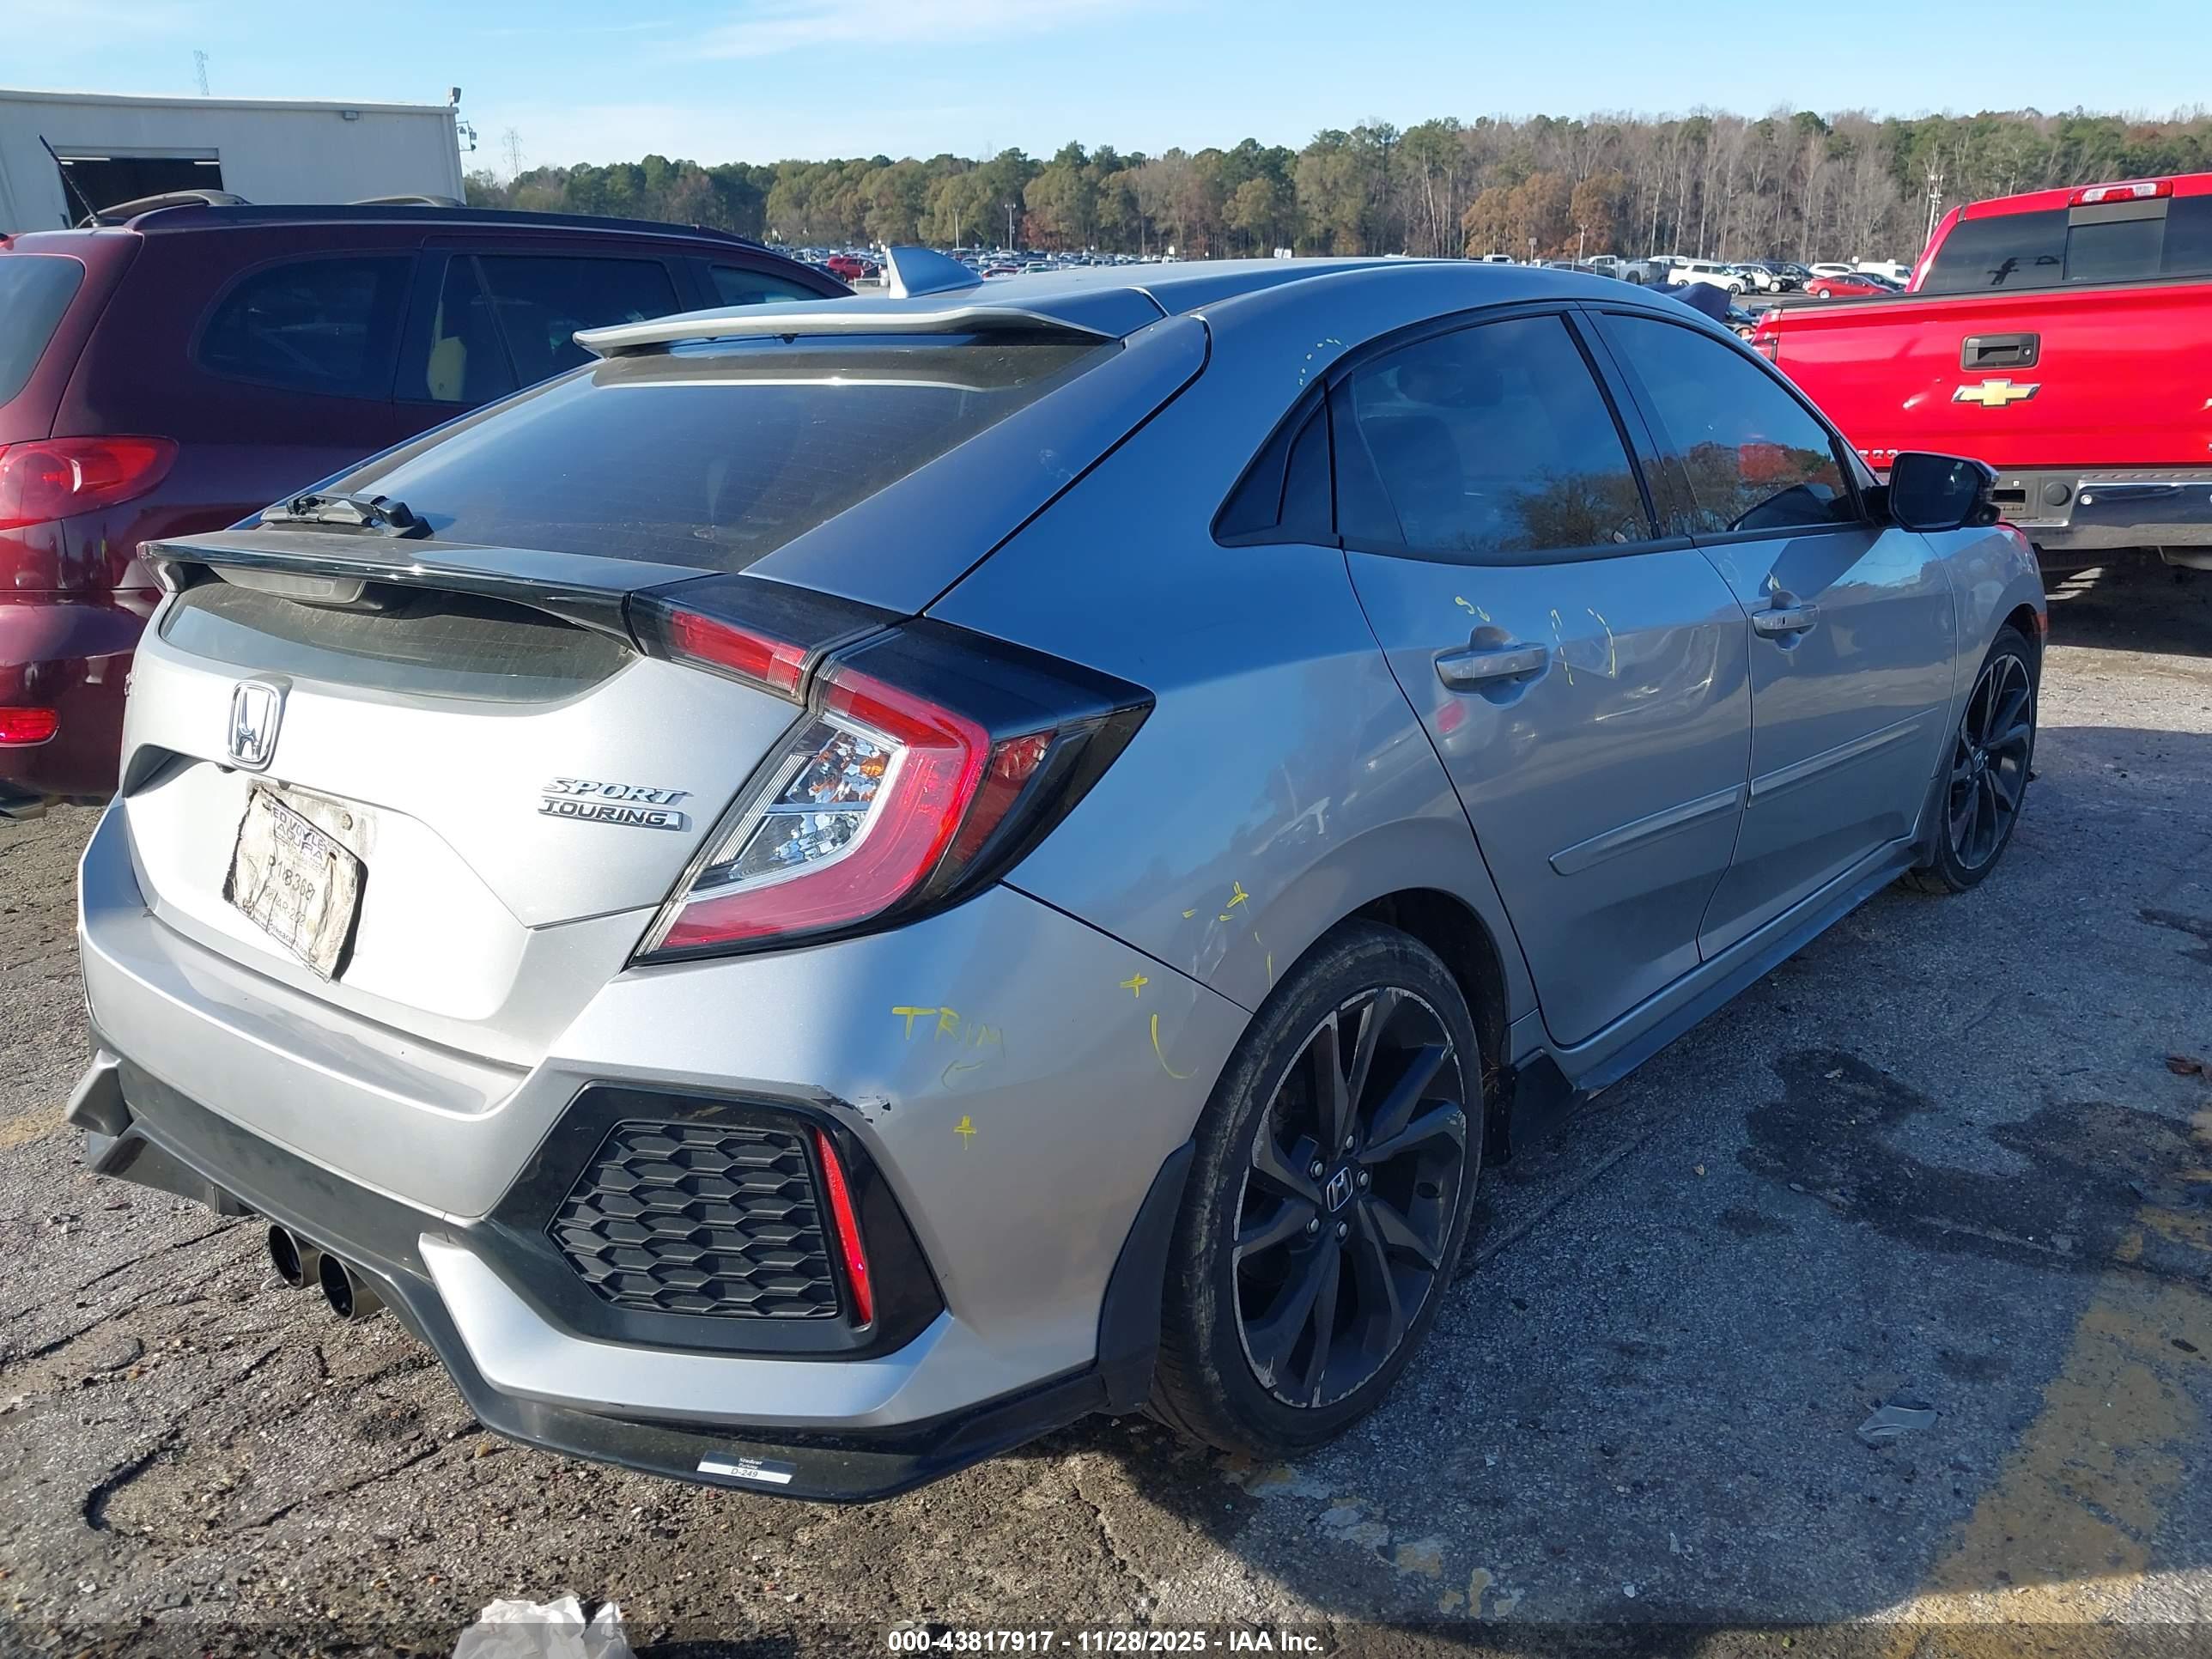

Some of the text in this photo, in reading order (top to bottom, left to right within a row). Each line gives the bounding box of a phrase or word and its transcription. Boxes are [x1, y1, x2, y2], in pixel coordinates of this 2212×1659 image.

[542, 776, 692, 805] SPORT
[544, 799, 668, 826] TOURING
[892, 1006, 1006, 1059] TRIM
[730, 1467, 758, 1478] D-249
